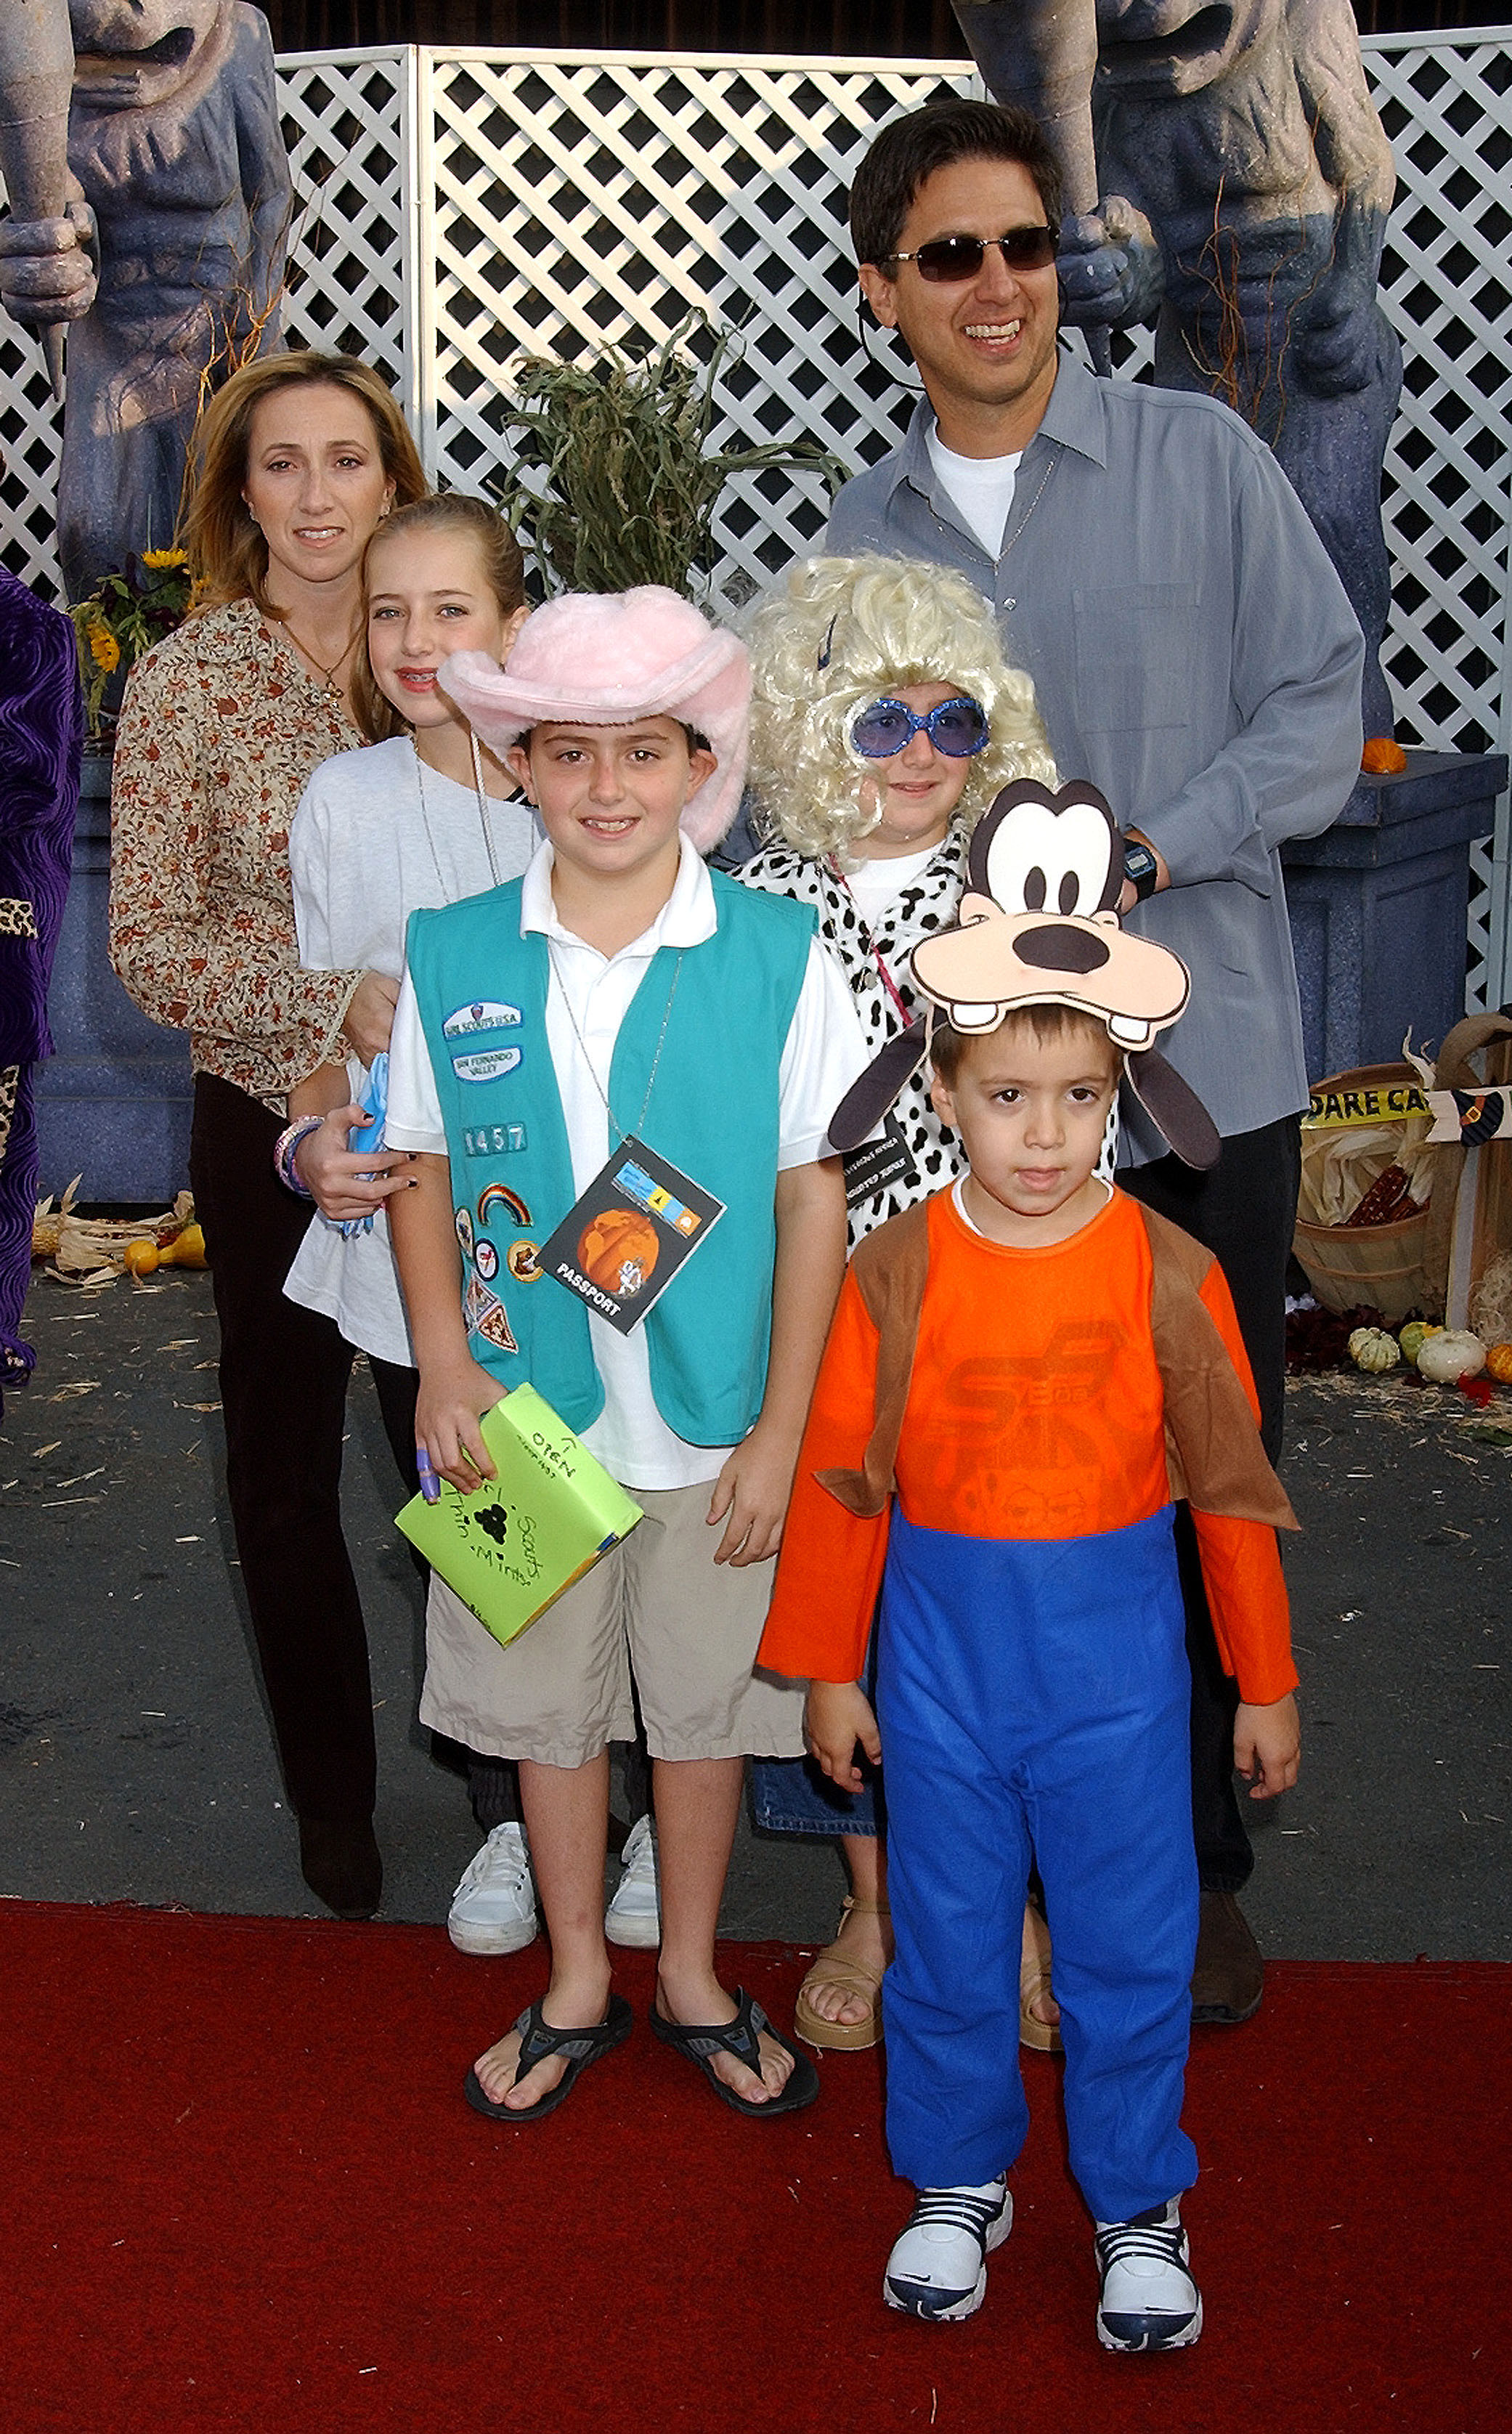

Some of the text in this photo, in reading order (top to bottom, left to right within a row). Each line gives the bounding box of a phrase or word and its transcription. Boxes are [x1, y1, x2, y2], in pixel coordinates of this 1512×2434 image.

[469, 1064, 497, 1076] VALLEY
[470, 1051, 513, 1066] FERNANDO
[465, 1127, 524, 1155] 1457
[557, 1263, 622, 1317] PASSPORT
[532, 1432, 577, 1478] OPEN
[516, 1515, 544, 1579] Scouts
